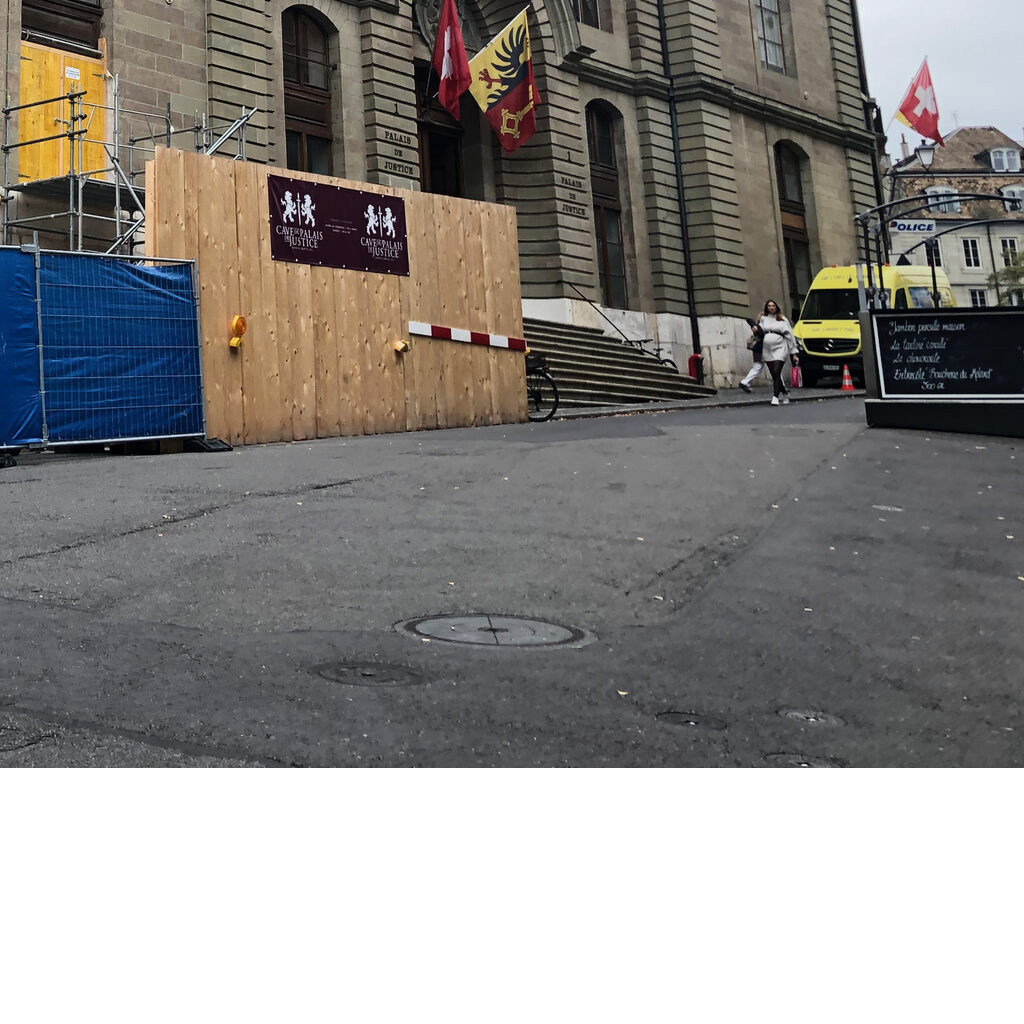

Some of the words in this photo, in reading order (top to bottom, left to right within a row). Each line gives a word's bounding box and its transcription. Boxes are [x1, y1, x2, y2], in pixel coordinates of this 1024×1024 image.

[384, 131, 411, 144] PALAIS
[394, 149, 403, 157] DE
[384, 161, 414, 175] JUSTICE
[560, 177, 582, 189] PALAIS
[562, 203, 586, 216] JUSTICE
[890, 220, 934, 231] POLICE
[276, 225, 295, 237] CAVE
[299, 228, 324, 241] PALAIS
[289, 236, 319, 249] JUSTICE
[360, 236, 377, 247] CAVE
[381, 239, 403, 251] PALAIS
[372, 247, 400, 259] JUSTICE
[890, 339, 900, 351] La
[893, 353, 903, 364] La
